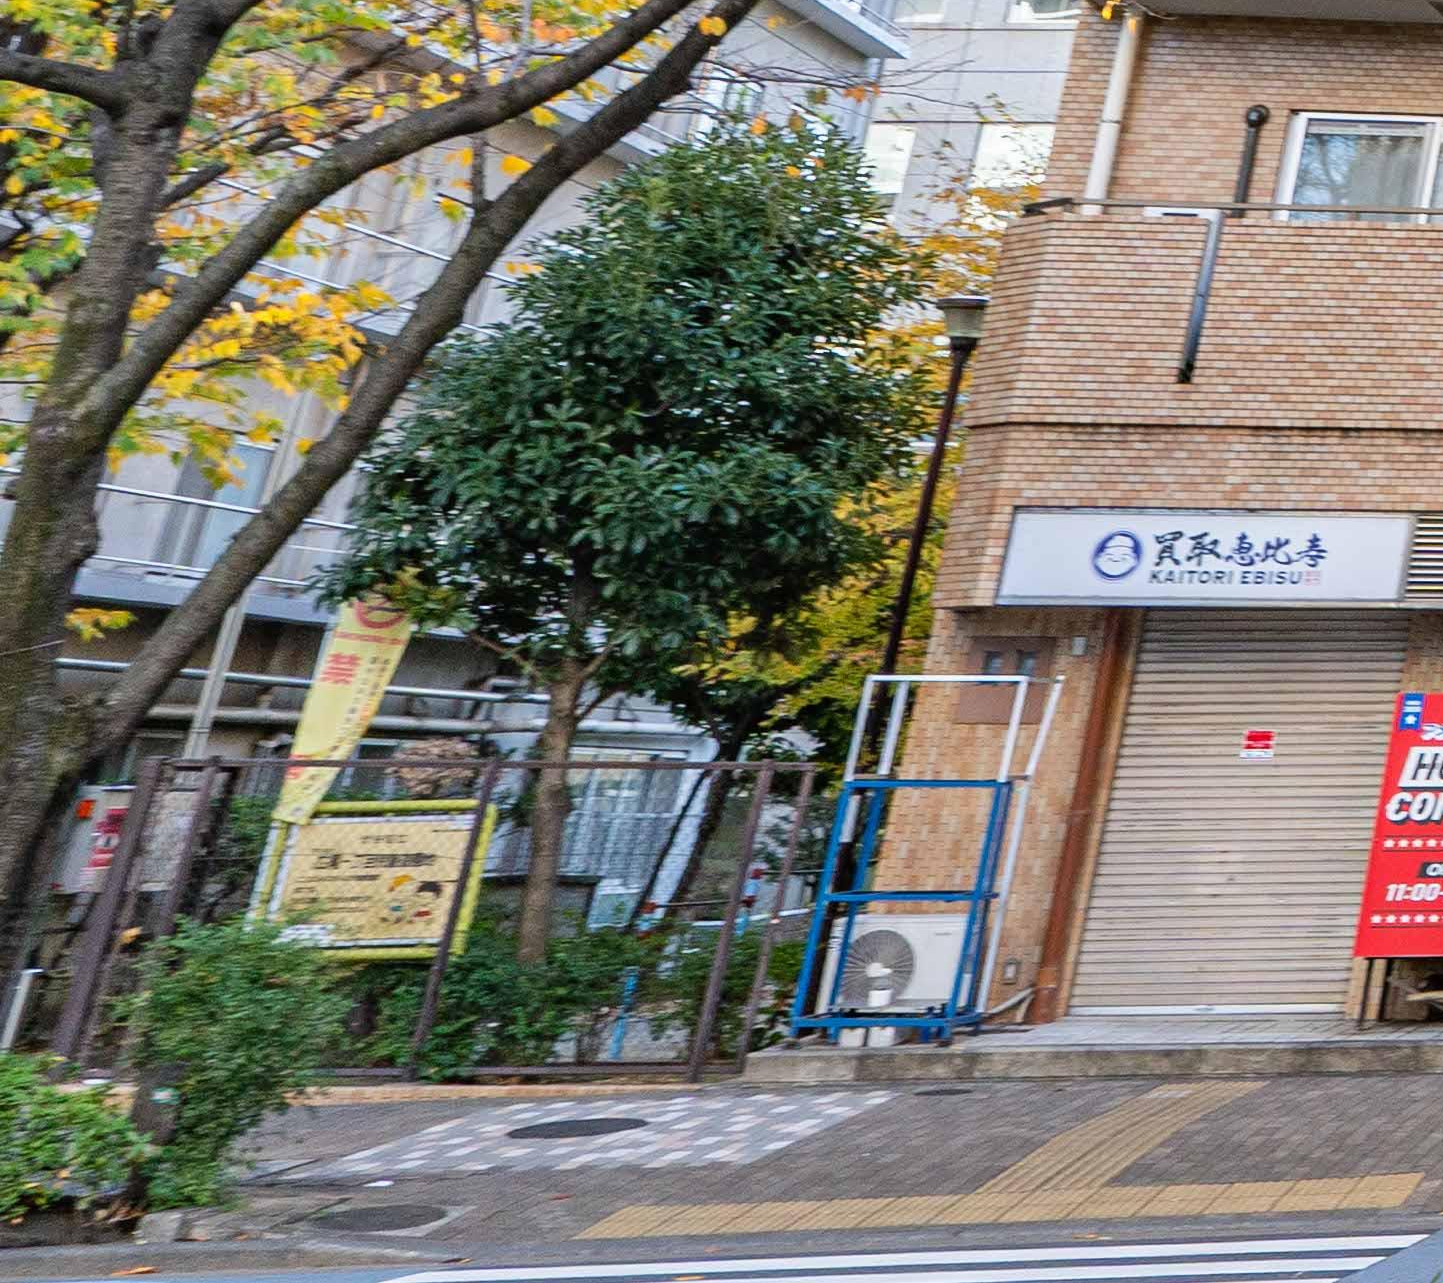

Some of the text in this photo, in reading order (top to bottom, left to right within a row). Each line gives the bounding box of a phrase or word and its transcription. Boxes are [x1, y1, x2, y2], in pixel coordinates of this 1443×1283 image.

[1151, 530, 1329, 567] 買取恵比寿
[1149, 570, 1233, 585] KAITORI
[1239, 570, 1303, 585] EBISU
